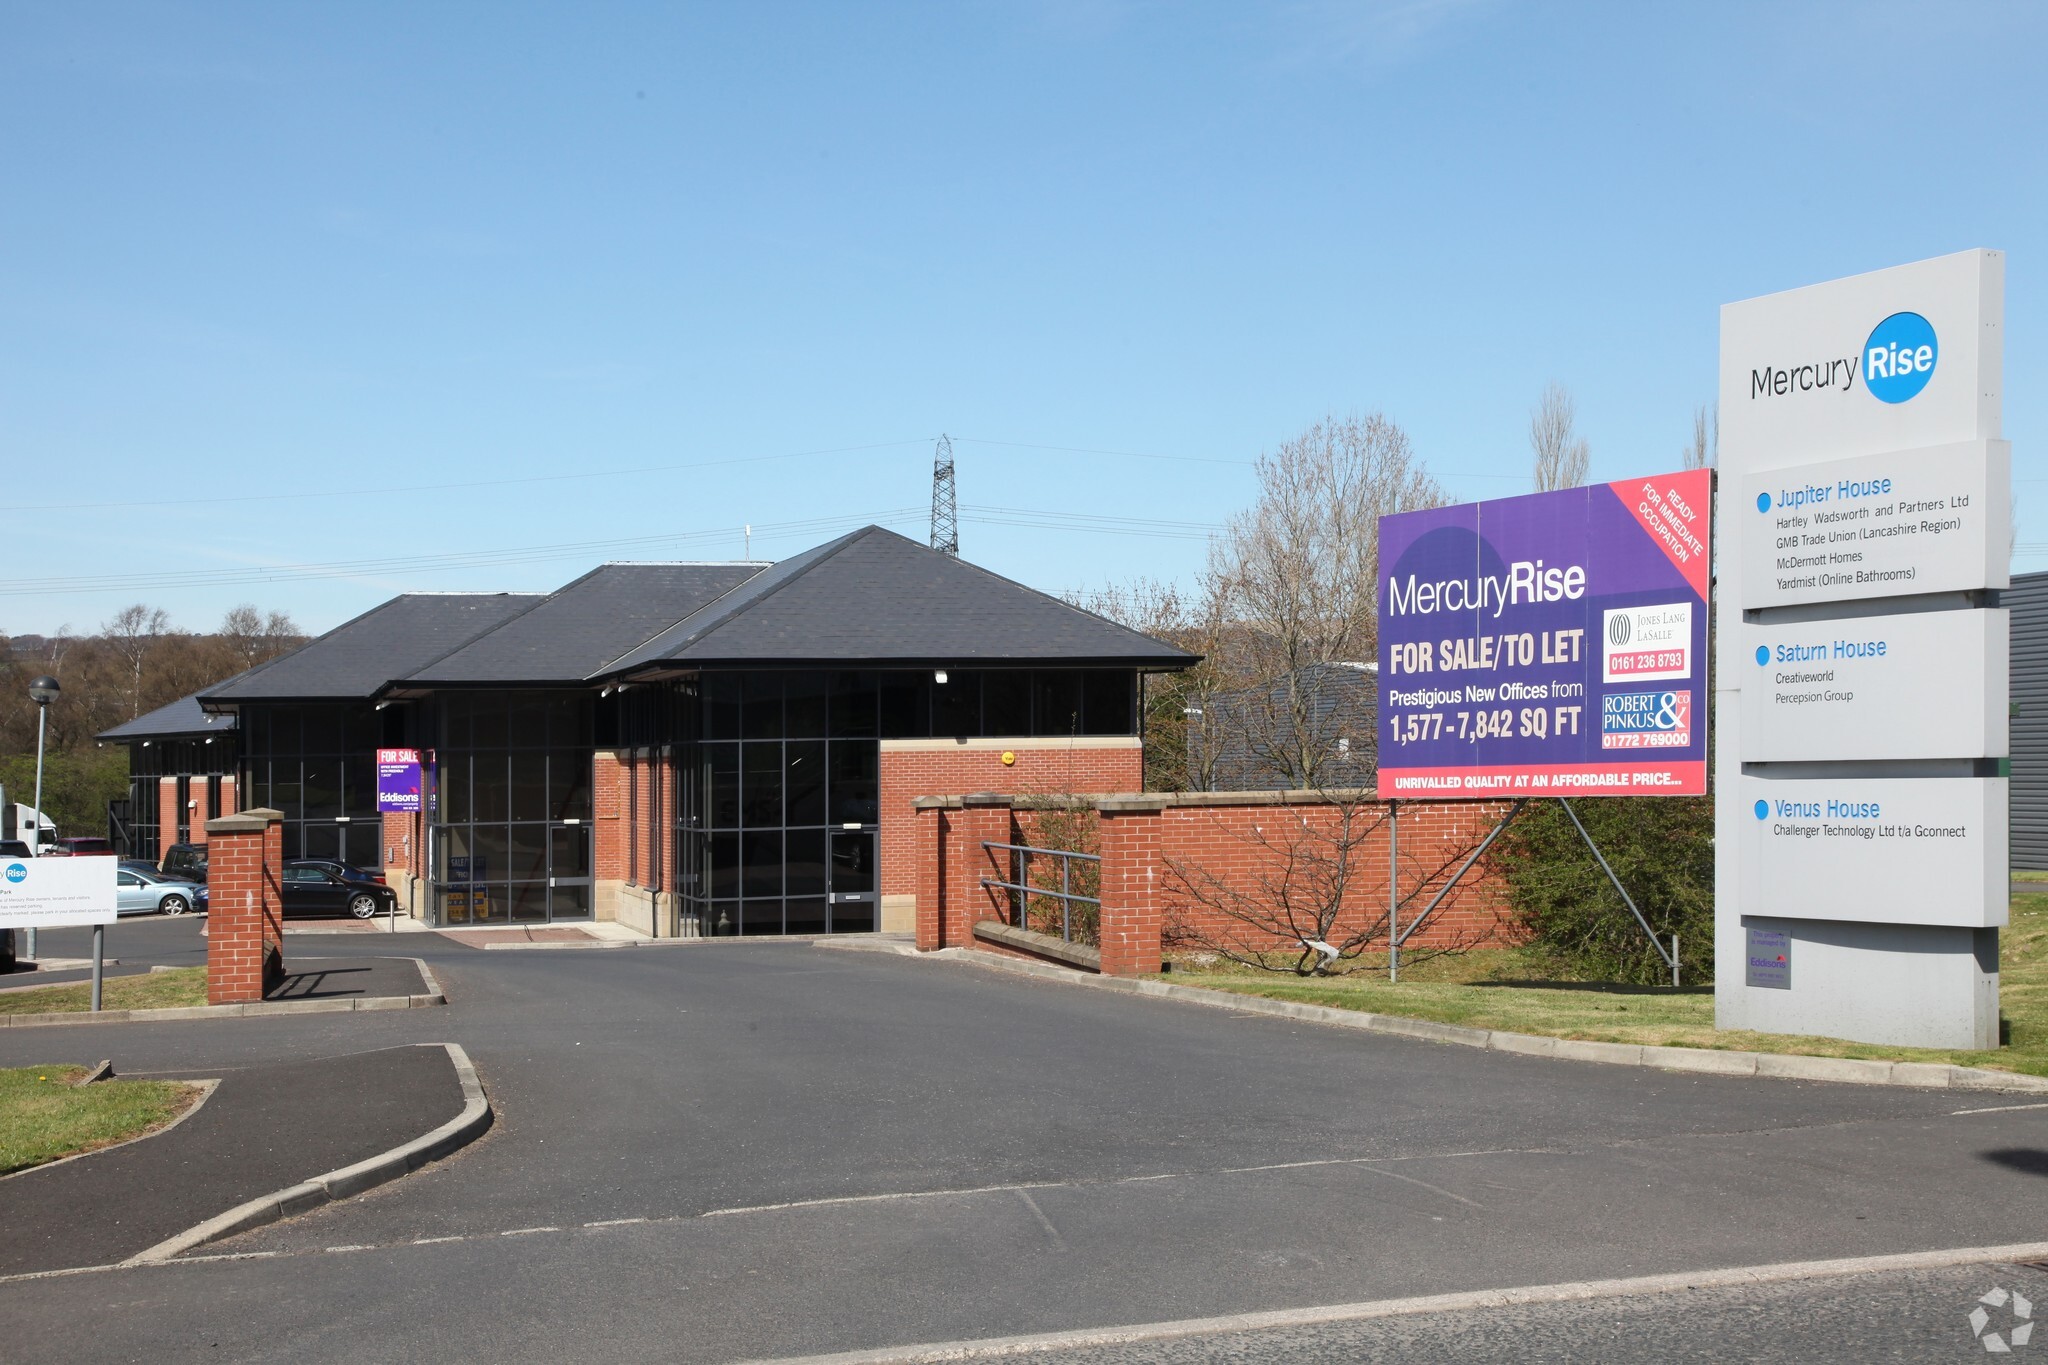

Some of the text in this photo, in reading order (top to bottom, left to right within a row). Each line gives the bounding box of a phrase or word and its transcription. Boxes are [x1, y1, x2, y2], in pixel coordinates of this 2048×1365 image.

[1752, 341, 1933, 400] Mercury Rise
[1777, 478, 1892, 510] Jupiter House
[1667, 489, 1696, 522] READY
[1776, 495, 1969, 530] Hartley Wadsworth and Partners Ltd
[1642, 483, 1703, 556] FOR IMMEDIATE
[1639, 502, 1689, 563] OCCUPATION
[1776, 517, 1961, 549] GMB Trade Union (Lancashire Region)
[1776, 550, 1863, 569] McDermott Homes
[1776, 566, 1916, 590] Yardmist (Online Bathrooms)
[1390, 641, 1433, 674] FOR
[1542, 628, 1584, 664] LET
[1612, 652, 1682, 671] 0161 236 8793
[1776, 640, 1887, 663] Saturn House
[1775, 670, 1834, 684] Creativeworld
[1389, 680, 1583, 709] Prestigious New Offices from
[1604, 694, 1656, 713] ROBERT
[1775, 690, 1854, 705] Percepsion Group
[1604, 692, 1690, 729] PINKUS & CO
[1520, 707, 1548, 740] SQ
[1555, 706, 1582, 735] FT
[1603, 732, 1689, 747] 01772 769000
[381, 750, 418, 762] FOR SALE
[1395, 772, 1682, 789] UNRIVALLED QUALITY AT AN AFFORDABLE PRICE...
[380, 792, 419, 802] Eddisons
[1774, 799, 1880, 818] Venus House
[1773, 823, 1966, 840] Challenger Technology Ltd t/a Gconnect
[7, 869, 26, 878] Rise
[1750, 956, 1786, 968] Eddisons
